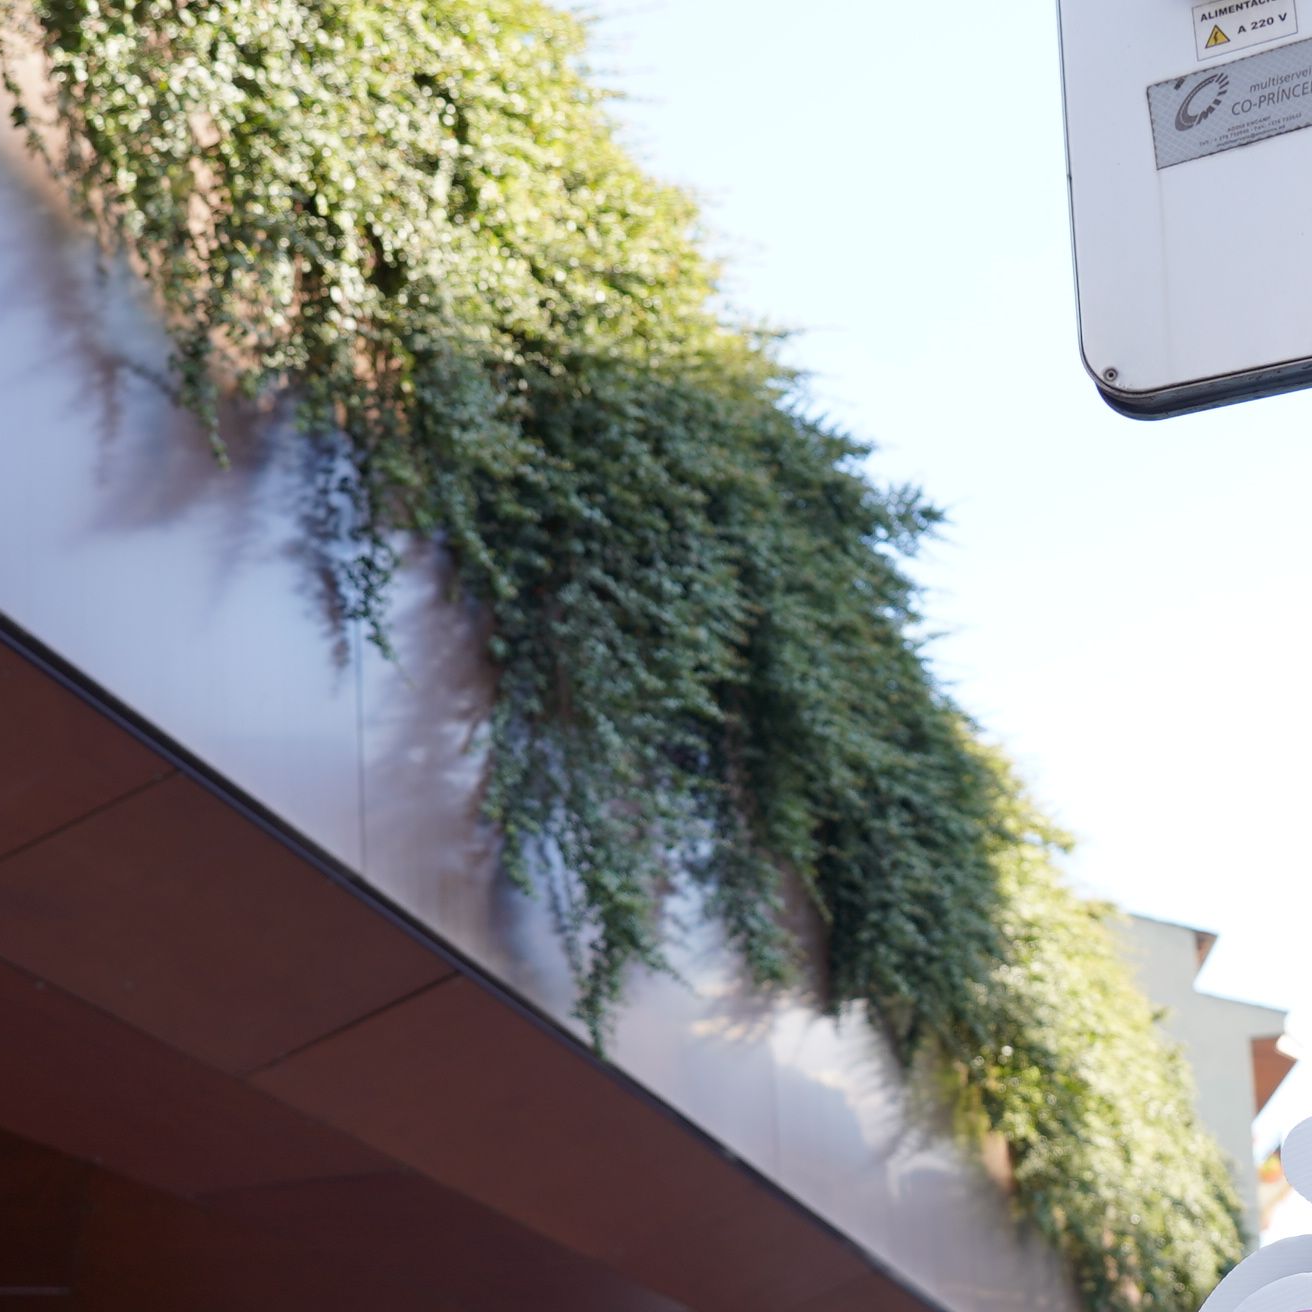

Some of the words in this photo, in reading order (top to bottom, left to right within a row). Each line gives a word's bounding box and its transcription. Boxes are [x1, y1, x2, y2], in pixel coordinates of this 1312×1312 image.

[1237, 25, 1246, 34] A
[1251, 17, 1274, 31] 220
[1278, 12, 1287, 22] V
